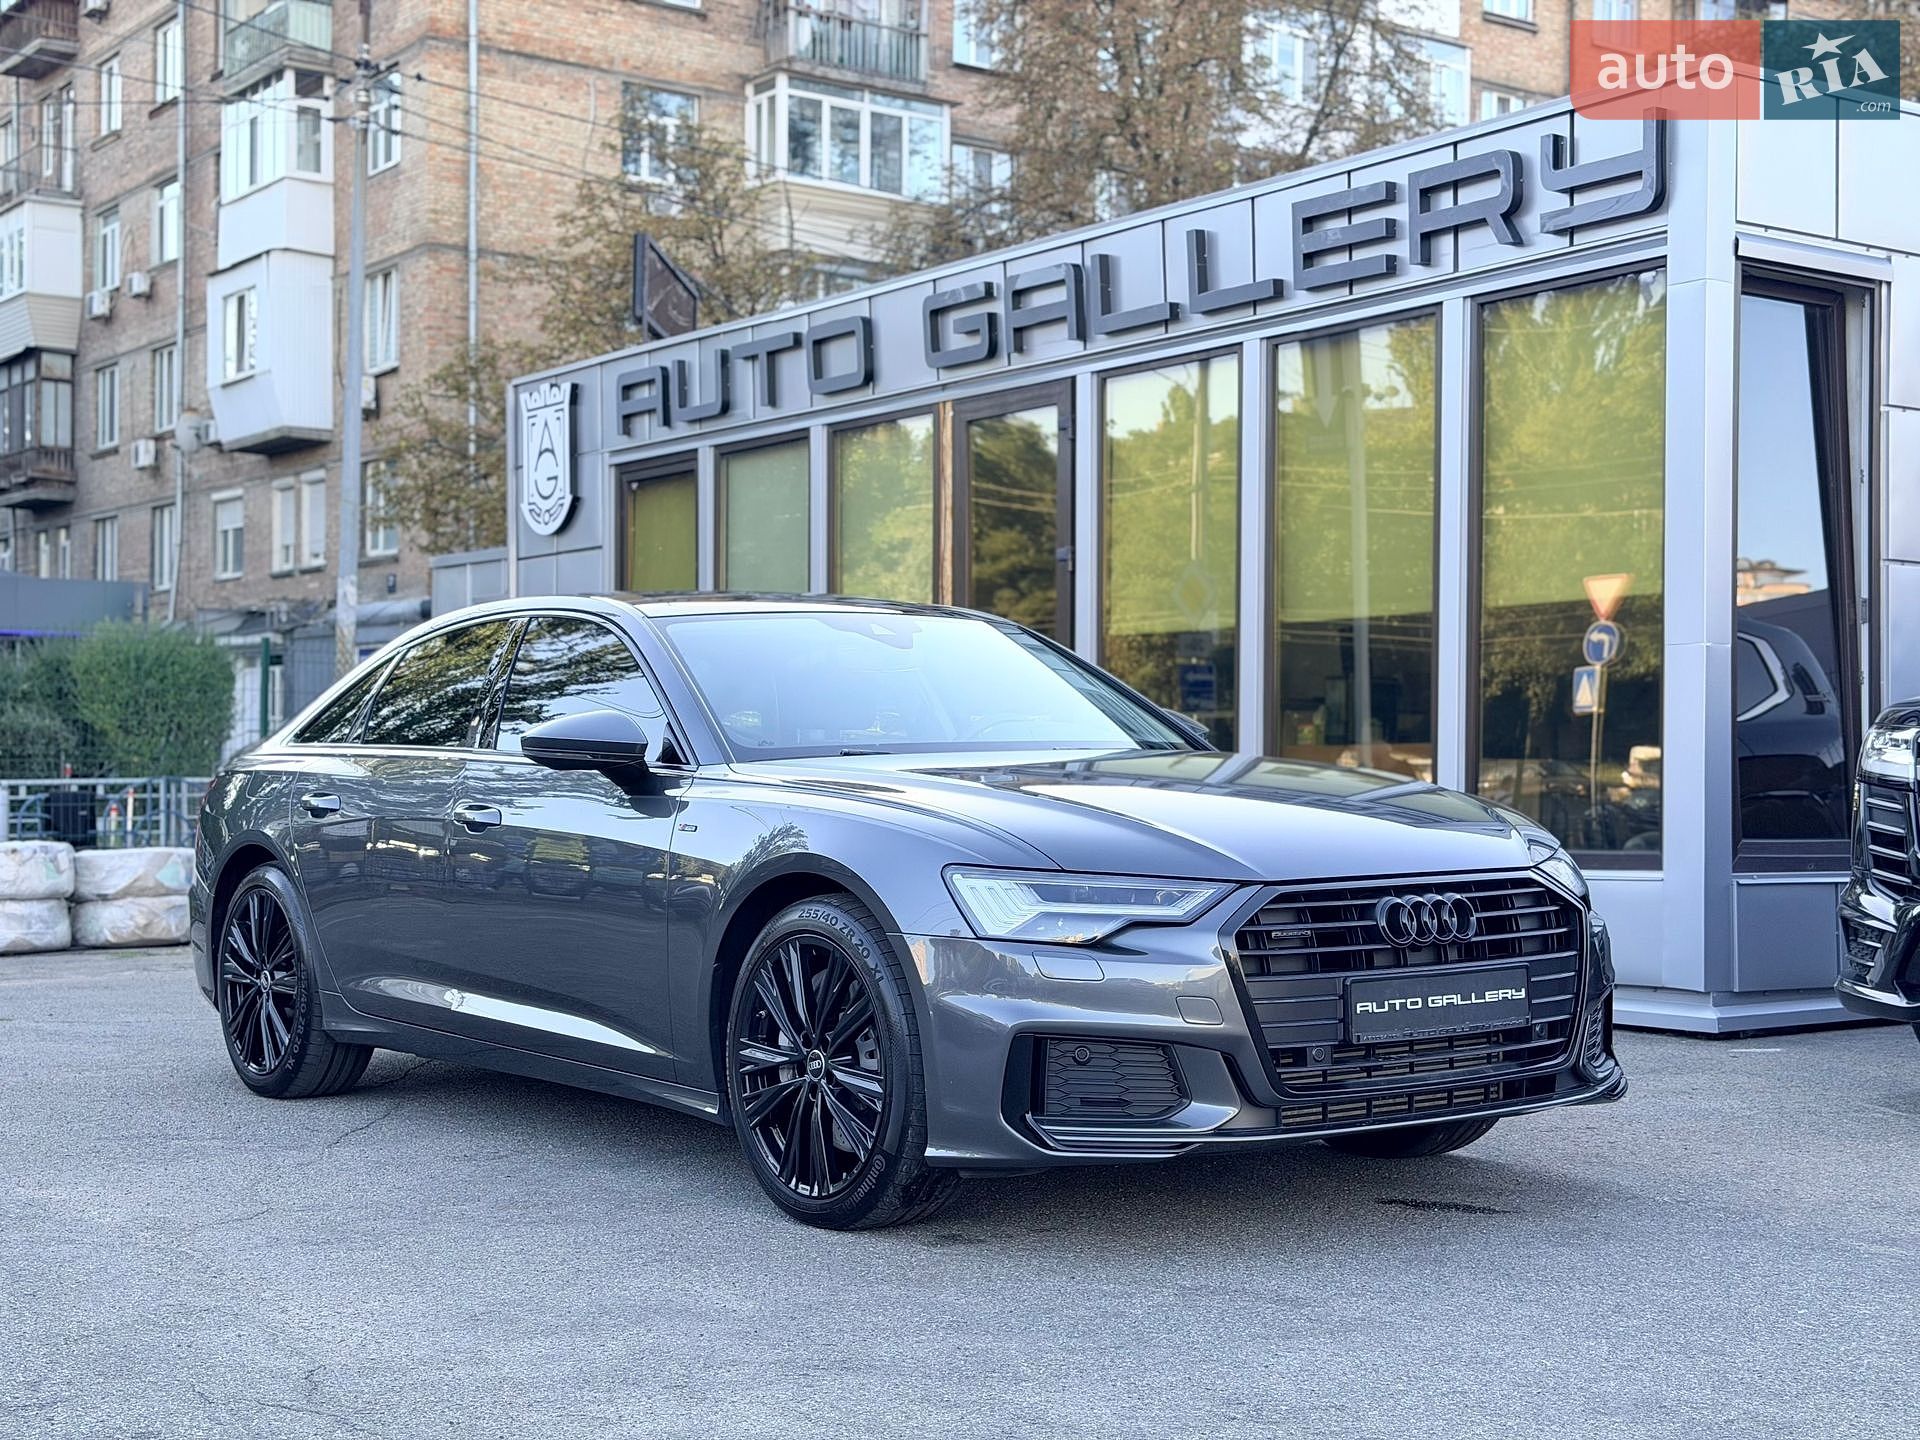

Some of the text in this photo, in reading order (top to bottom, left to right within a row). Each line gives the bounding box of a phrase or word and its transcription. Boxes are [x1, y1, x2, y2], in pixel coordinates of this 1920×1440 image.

[617, 106, 1669, 437] AUTO GALLERY
[798, 908, 838, 927] 255/40
[839, 922, 856, 942] ZR
[854, 938, 871, 960] 20
[1356, 987, 1526, 1014] AUTO GALLERY
